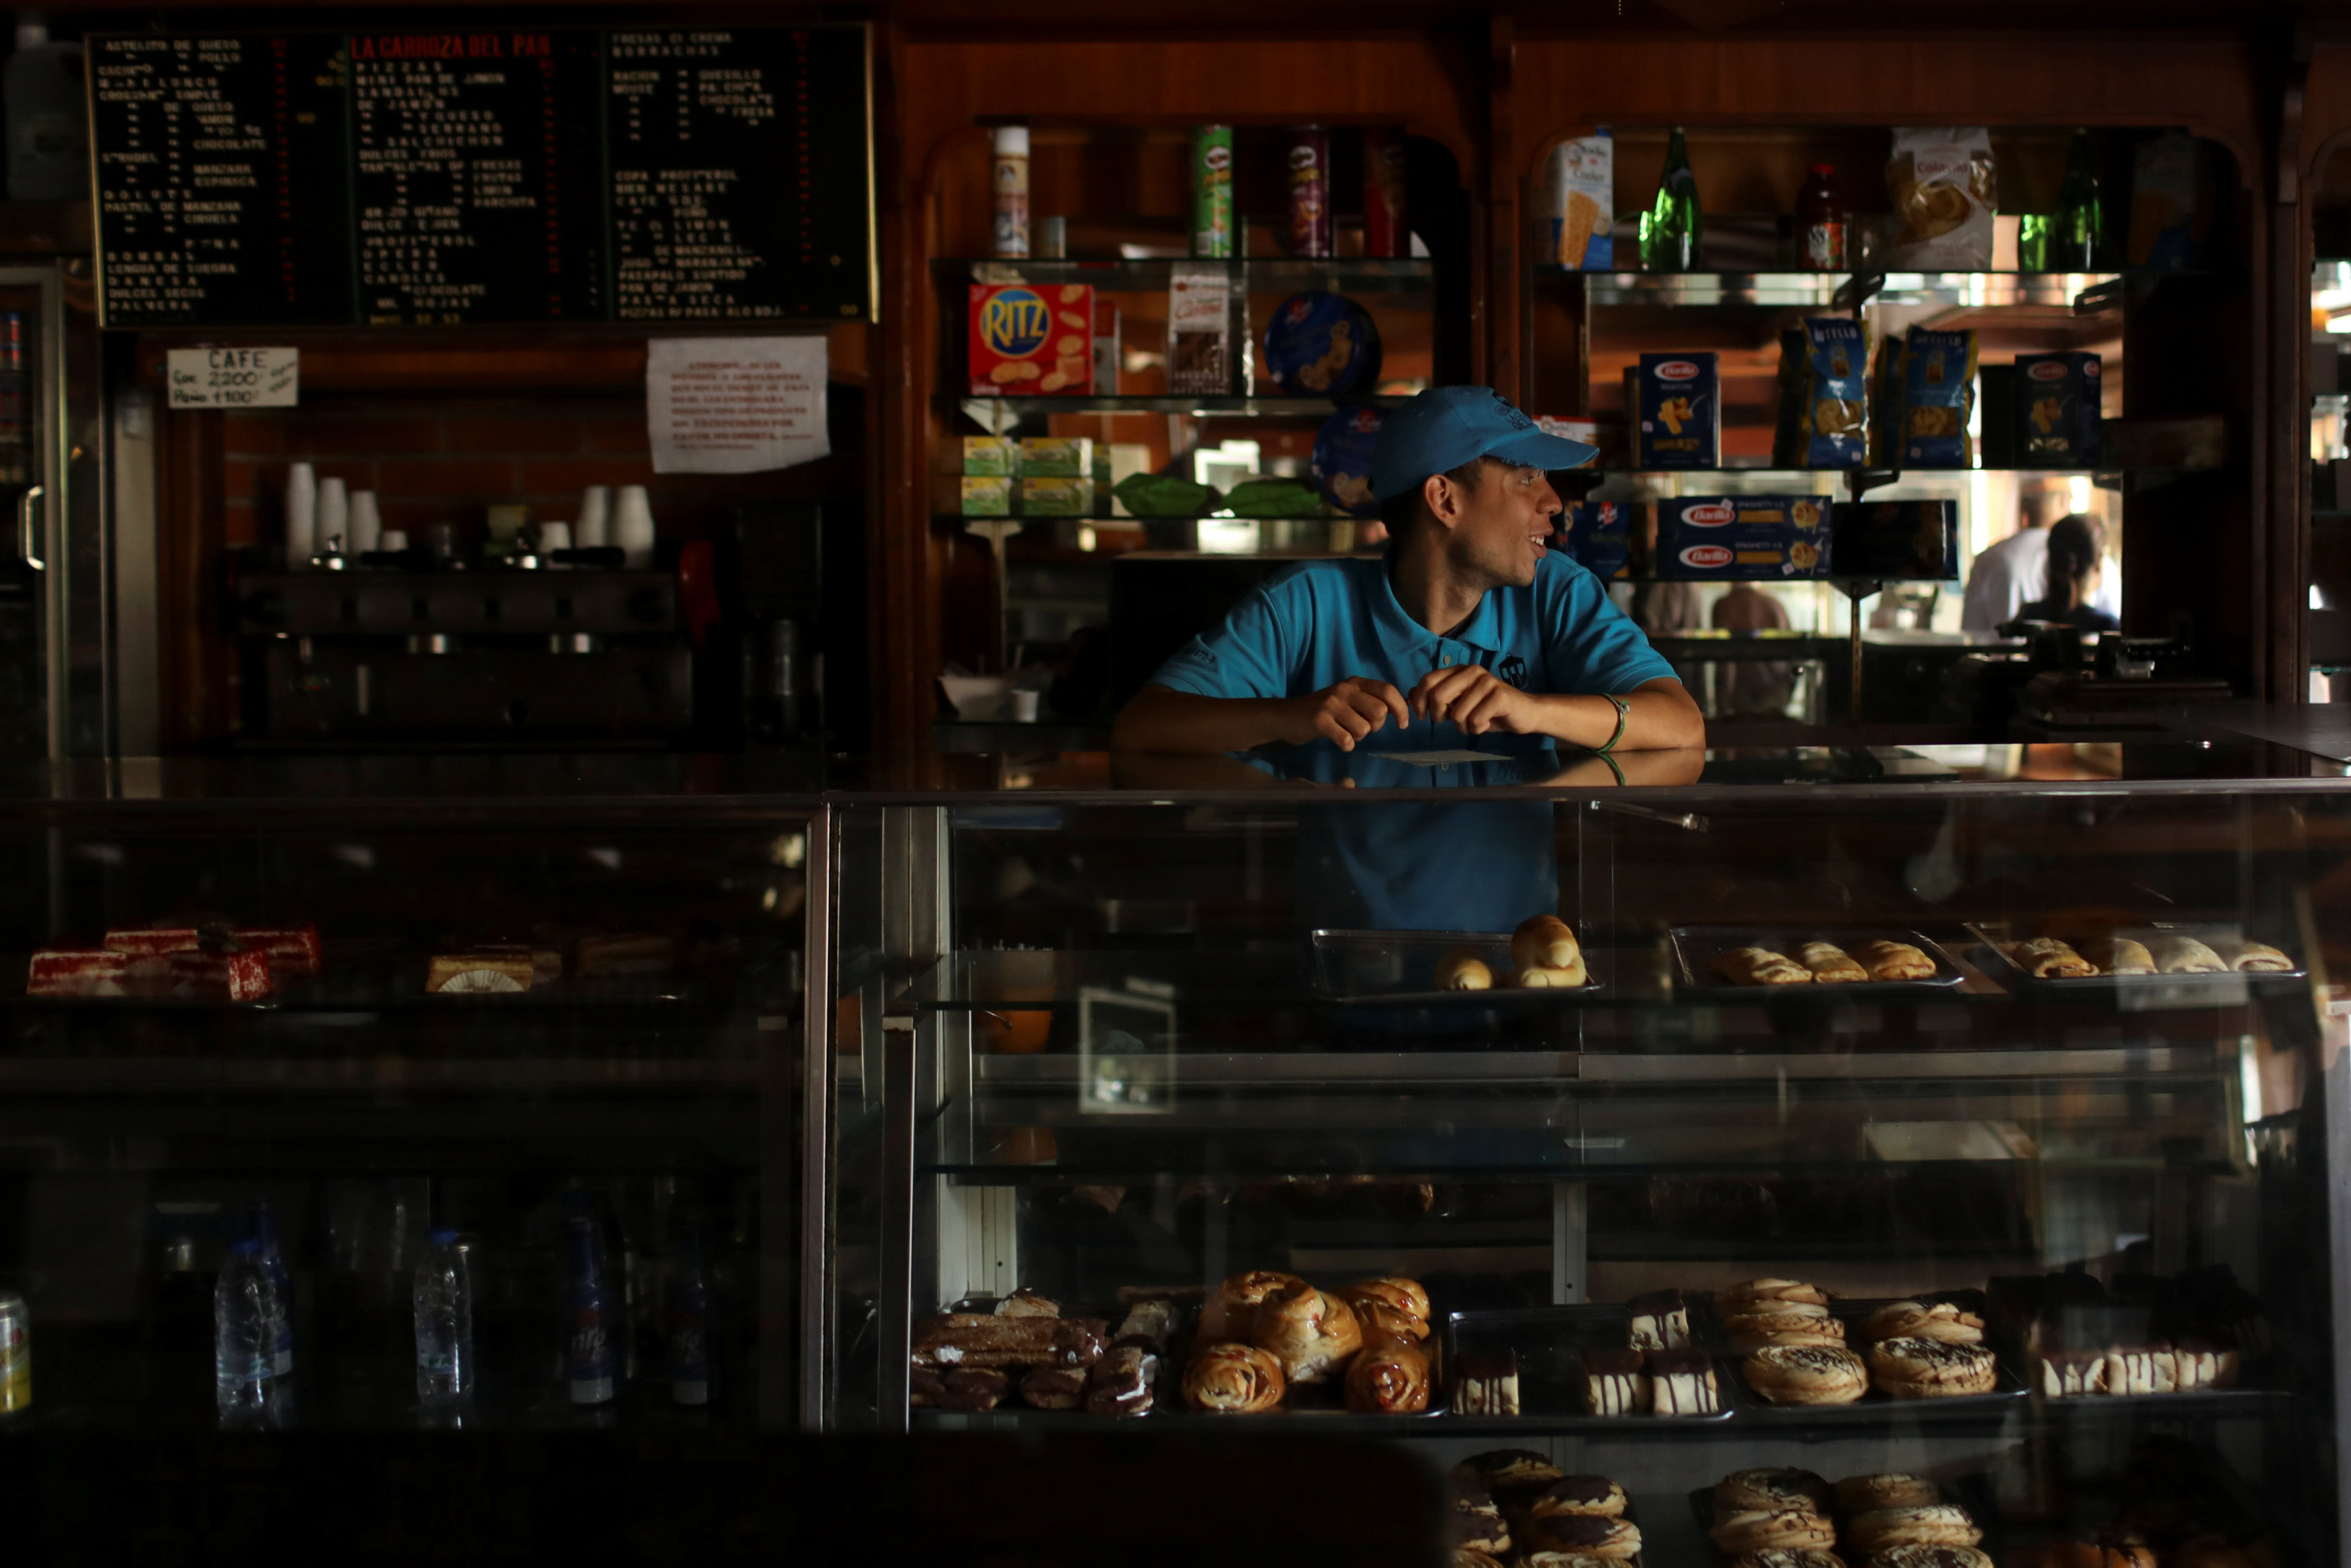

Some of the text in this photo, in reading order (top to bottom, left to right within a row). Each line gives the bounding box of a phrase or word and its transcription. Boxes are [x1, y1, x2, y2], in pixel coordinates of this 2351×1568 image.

[351, 34, 551, 60] LA CARROZA DEL PAN
[199, 52, 240, 62] POLLO
[357, 62, 441, 73] PIZZAS
[406, 75, 432, 84] PAN
[175, 89, 220, 100] SIMPLE
[193, 139, 265, 149] CHOCOLATE
[194, 165, 251, 175] MANZANA
[105, 201, 240, 212] PASTEL DE MANZANA
[184, 214, 237, 224] CIRUELA
[985, 298, 1045, 349] RITZ
[209, 349, 268, 369] CAFE
